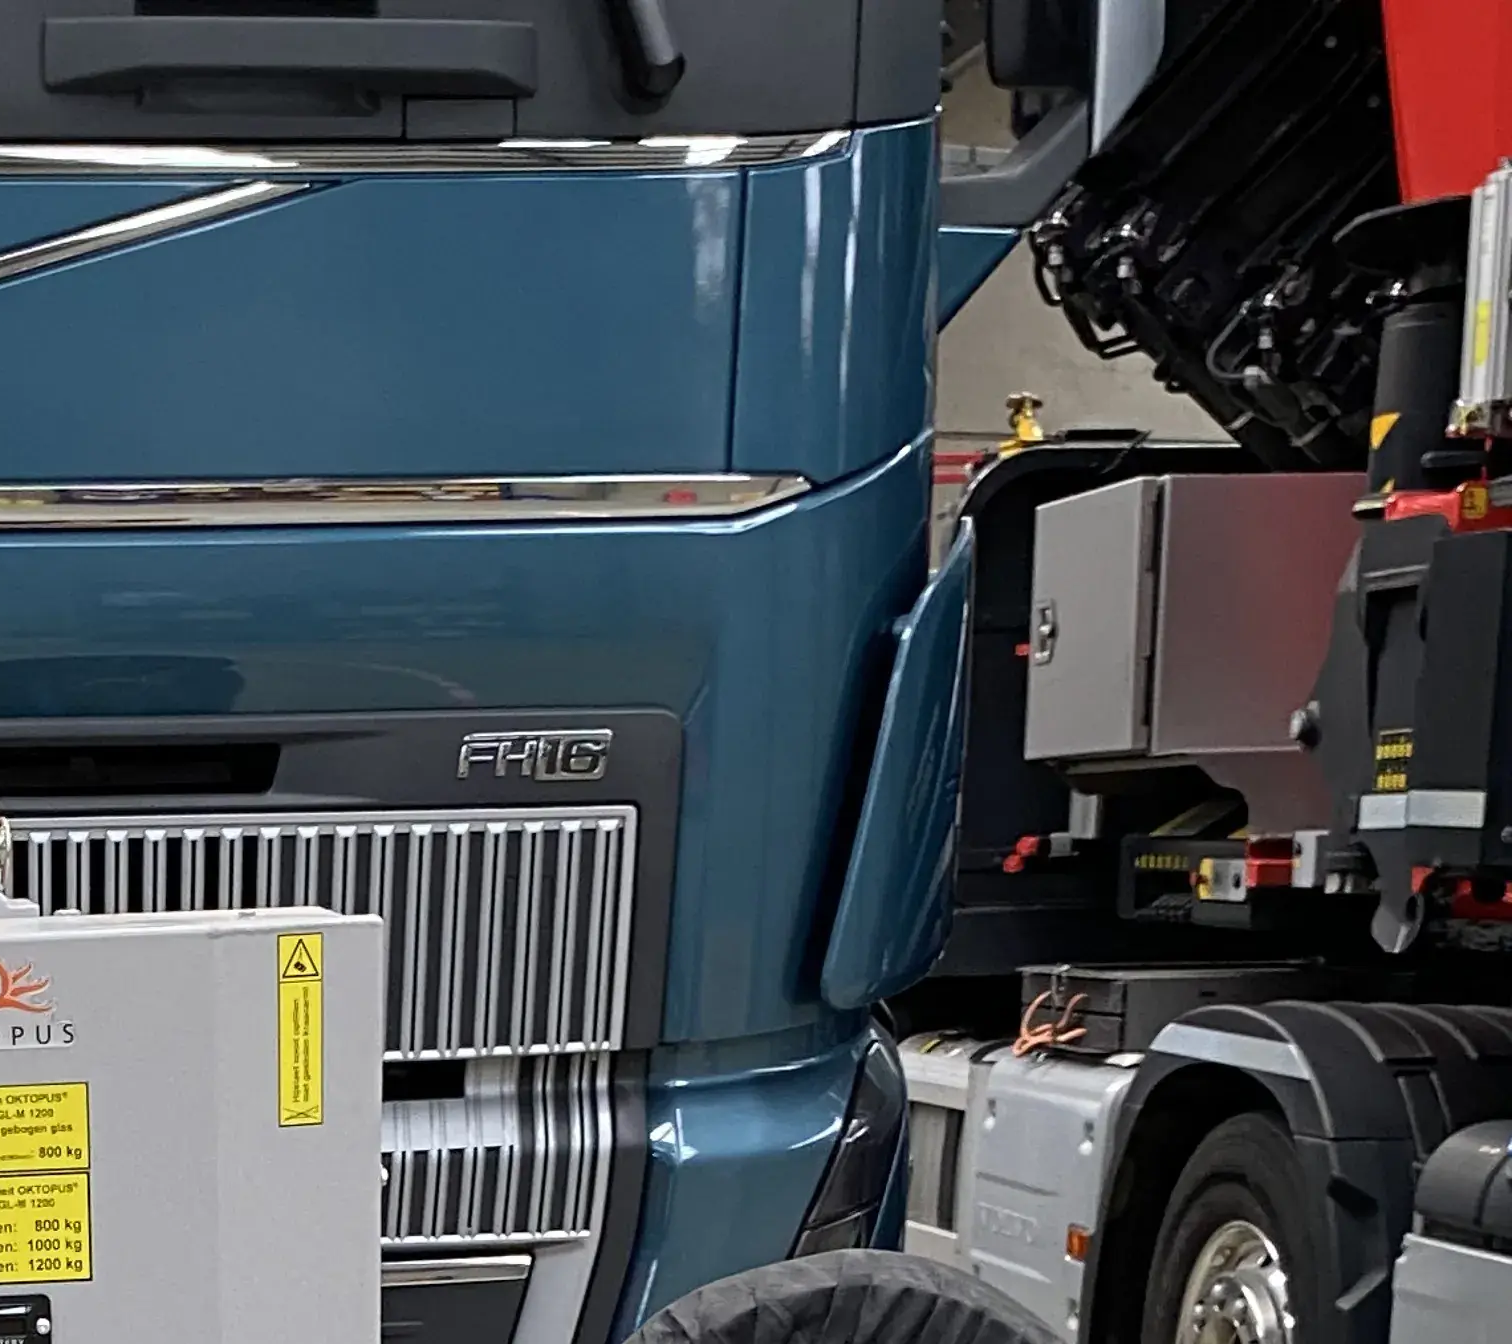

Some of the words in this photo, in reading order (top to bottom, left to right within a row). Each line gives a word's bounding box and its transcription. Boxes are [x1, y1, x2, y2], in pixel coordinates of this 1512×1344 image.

[456, 731, 613, 781] FH16
[38, 1146, 62, 1159] 800
[66, 1146, 82, 1160] kg
[34, 1219, 60, 1232] 800
[64, 1218, 82, 1234] kg
[27, 1239, 61, 1252] 1000
[65, 1238, 83, 1253] kg
[28, 1259, 62, 1272] 1200
[65, 1257, 83, 1272] kg
